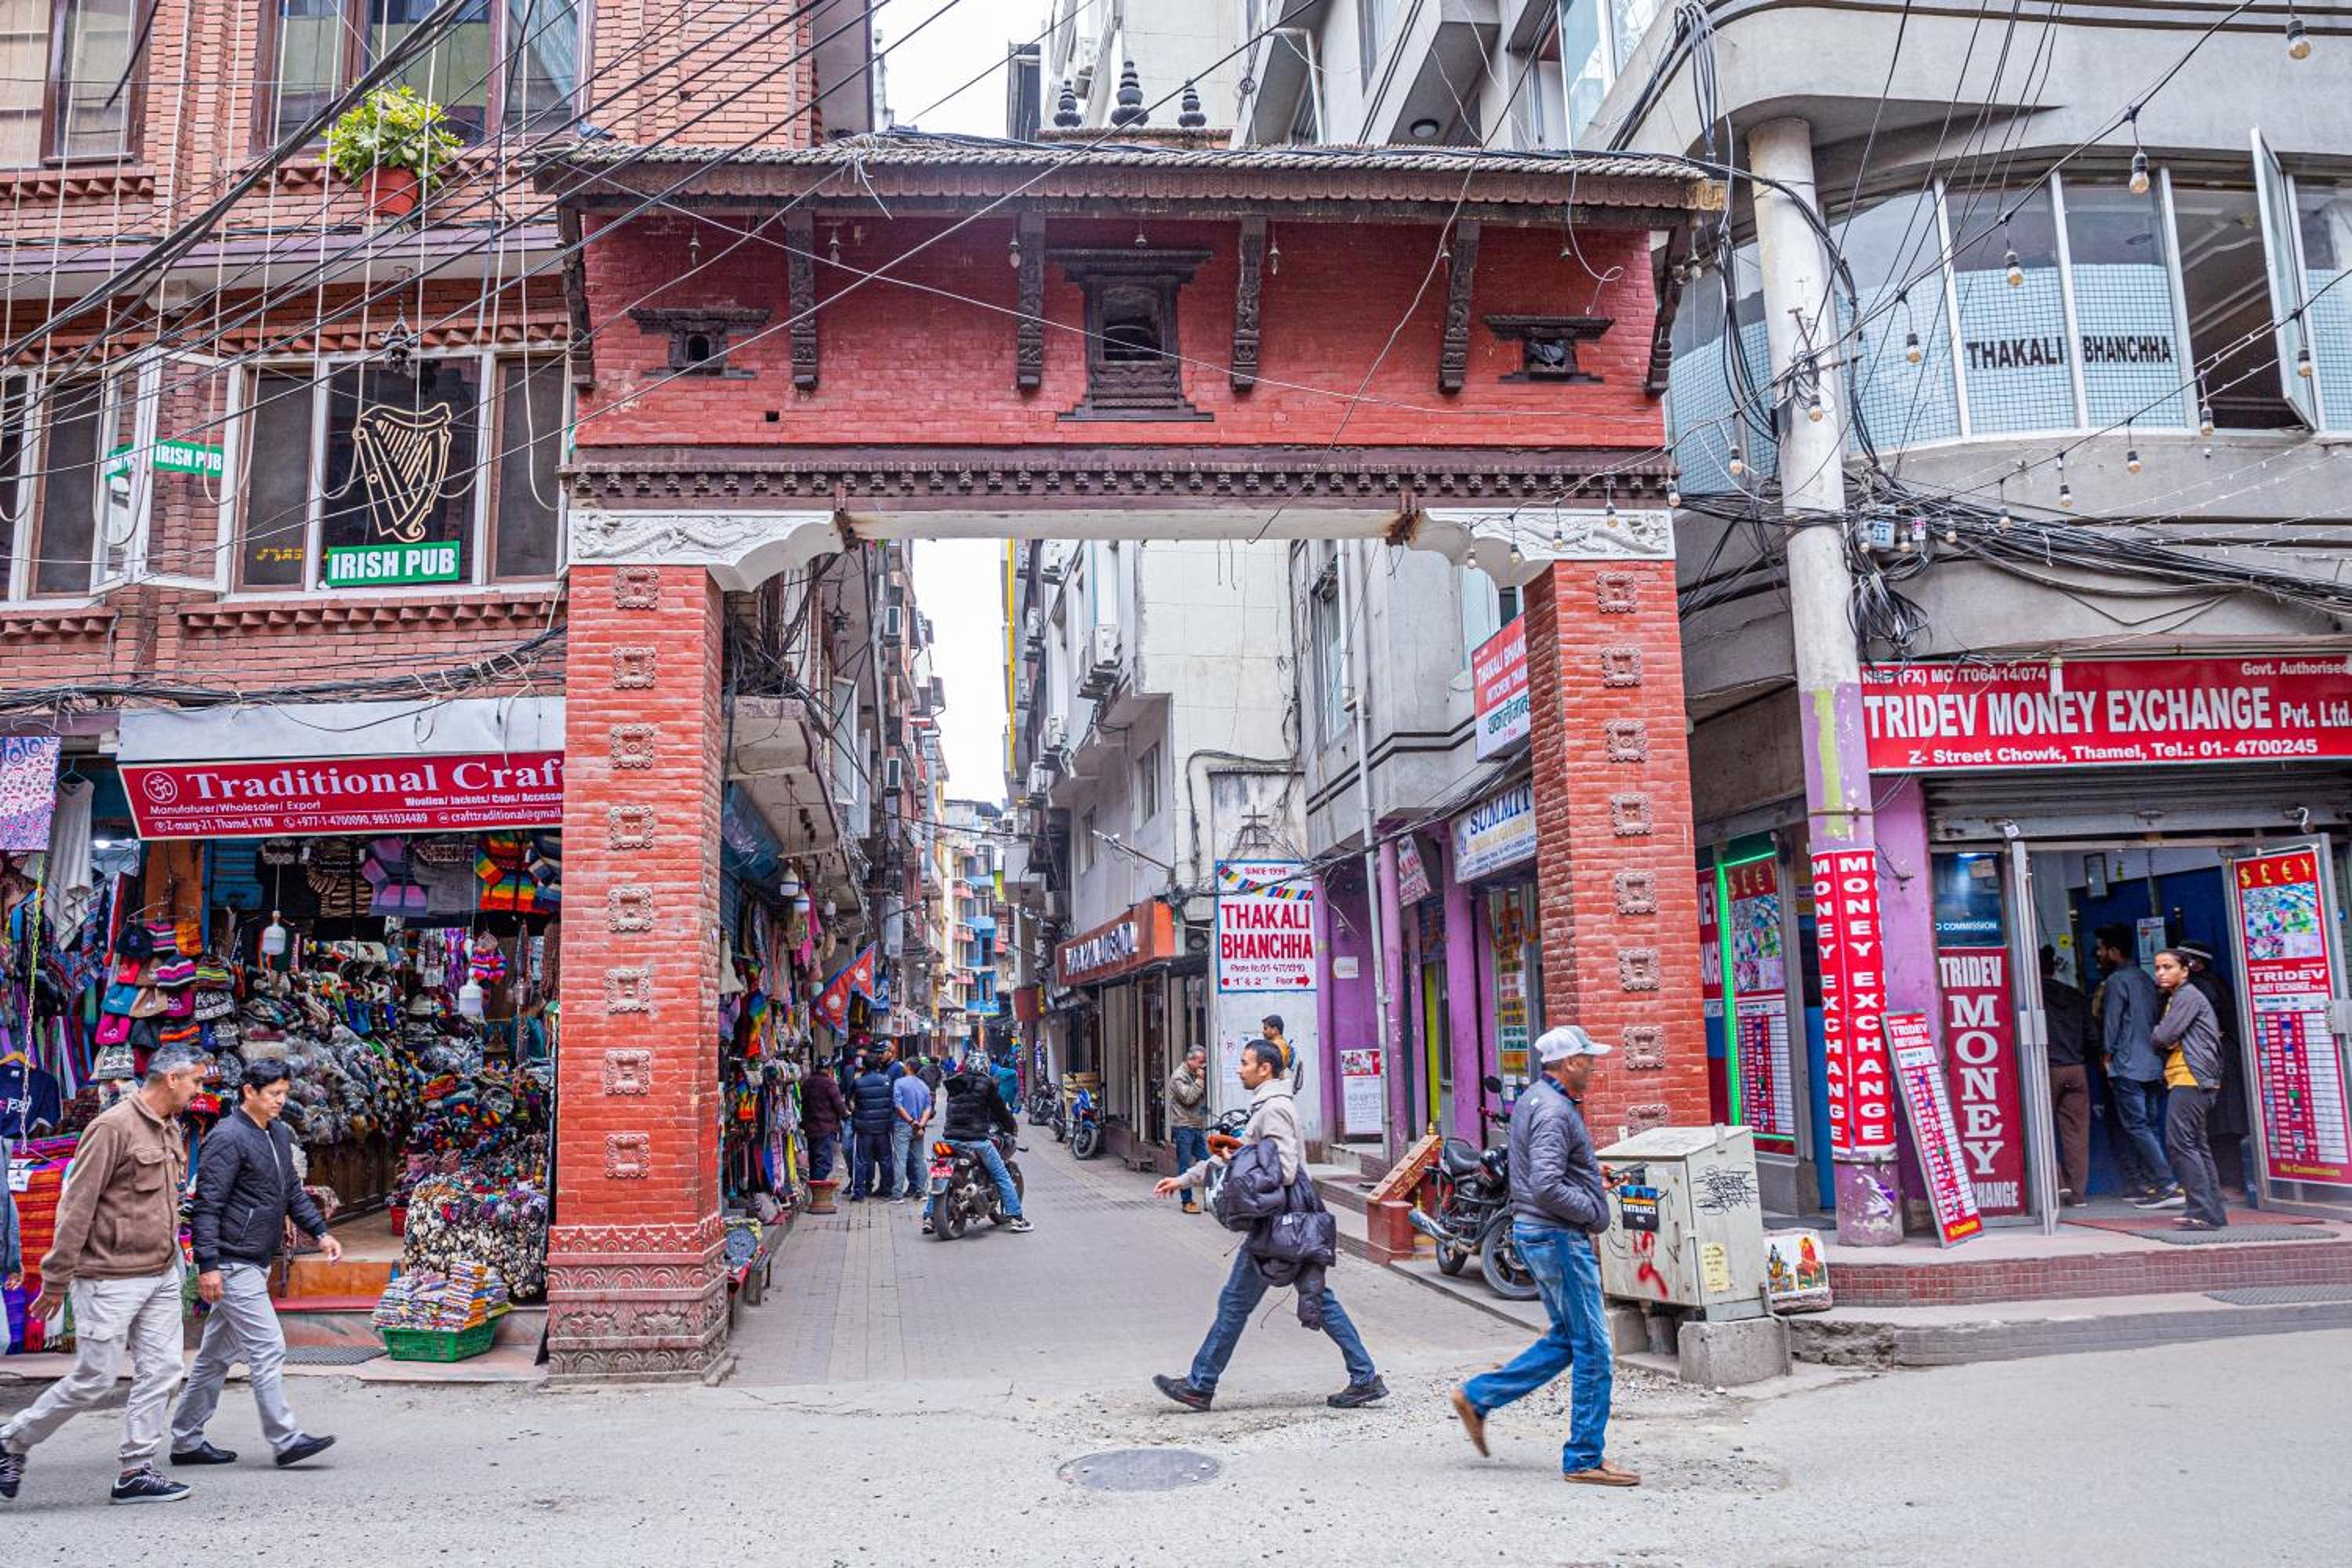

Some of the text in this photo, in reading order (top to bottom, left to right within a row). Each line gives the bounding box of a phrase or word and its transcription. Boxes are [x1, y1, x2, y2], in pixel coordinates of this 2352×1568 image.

[1966, 335, 2172, 368] THAKALI BHANCHHA
[155, 445, 193, 466] IRISH
[195, 452, 223, 470] PUB
[331, 551, 399, 579] IRISH
[405, 548, 456, 576] PUB
[1932, 669, 1954, 682] MC
[2241, 661, 2276, 676] Govt.
[1863, 687, 2352, 739] TRIDEV MONEY EXCHANGE Pvt. Ltd.
[1933, 749, 1993, 764] Street
[1997, 746, 2067, 763] Chowk,
[2071, 744, 2147, 760] Thamel,
[2234, 739, 2318, 754] 4700245
[187, 758, 564, 801] Traditional Craf
[287, 800, 321, 812] Export
[1470, 782, 1531, 836] SUMMIT
[1221, 904, 1311, 929] THAKALI
[1944, 921, 1997, 931] COMMISSION
[1221, 934, 1313, 959] BHANCHHA
[1938, 956, 2002, 988] TRIDEV
[2250, 969, 2325, 982] TRIDEV
[1813, 858, 1844, 1141] MONEY EXCHANGE
[1839, 857, 1886, 1140] MONEY EXCHANGE
[1948, 994, 2005, 1174] MONEY
[1971, 1181, 2019, 1208] HANGE
